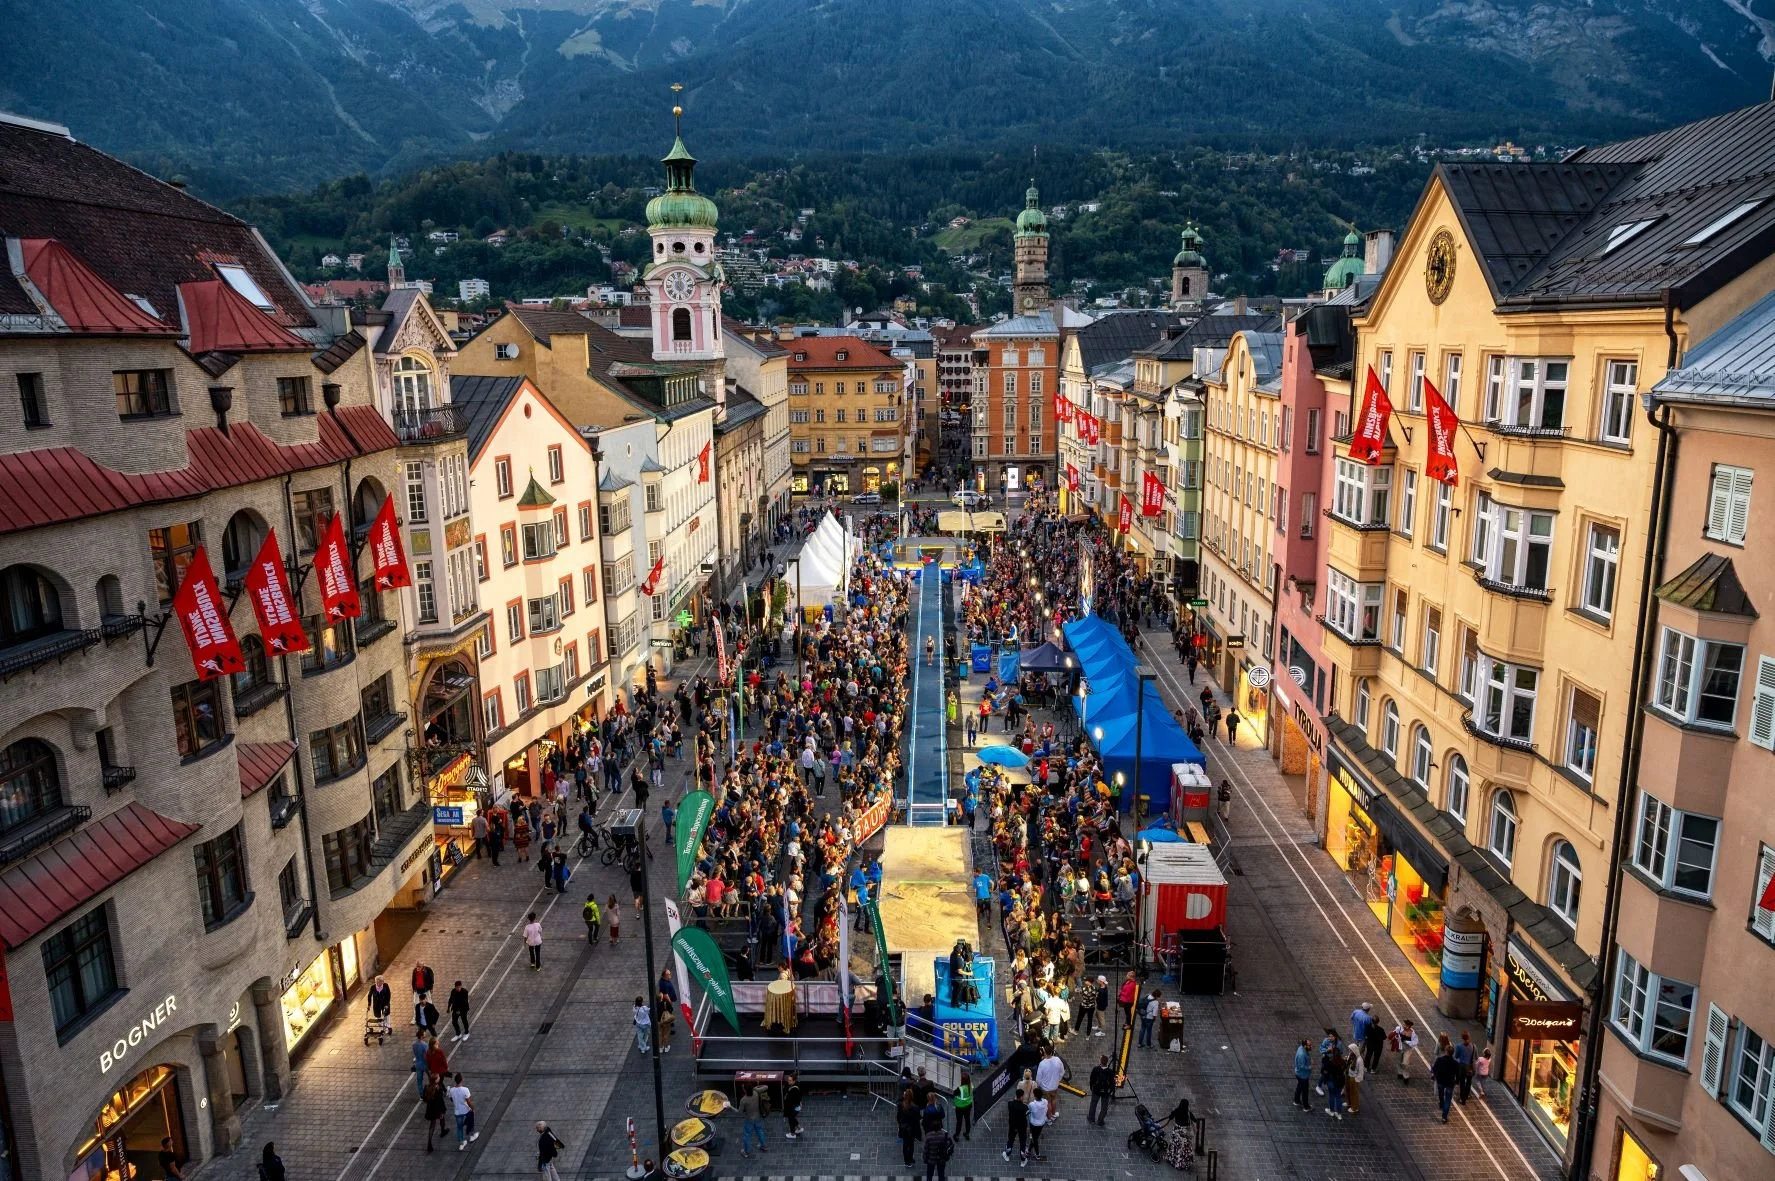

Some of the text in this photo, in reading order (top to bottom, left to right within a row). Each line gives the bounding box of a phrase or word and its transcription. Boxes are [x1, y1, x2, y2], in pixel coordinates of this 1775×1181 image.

[1363, 391, 1379, 438] INNSBRUCK
[1432, 406, 1446, 456] INNSBRUCK
[1294, 699, 1323, 756] TYROLIA
[1339, 766, 1370, 811] HUMANIC
[100, 995, 177, 1074] BOGNER
[943, 1022, 988, 1031] GOLDEN
[943, 1030, 989, 1048] FLY
[1518, 1017, 1576, 1028] Weigand
